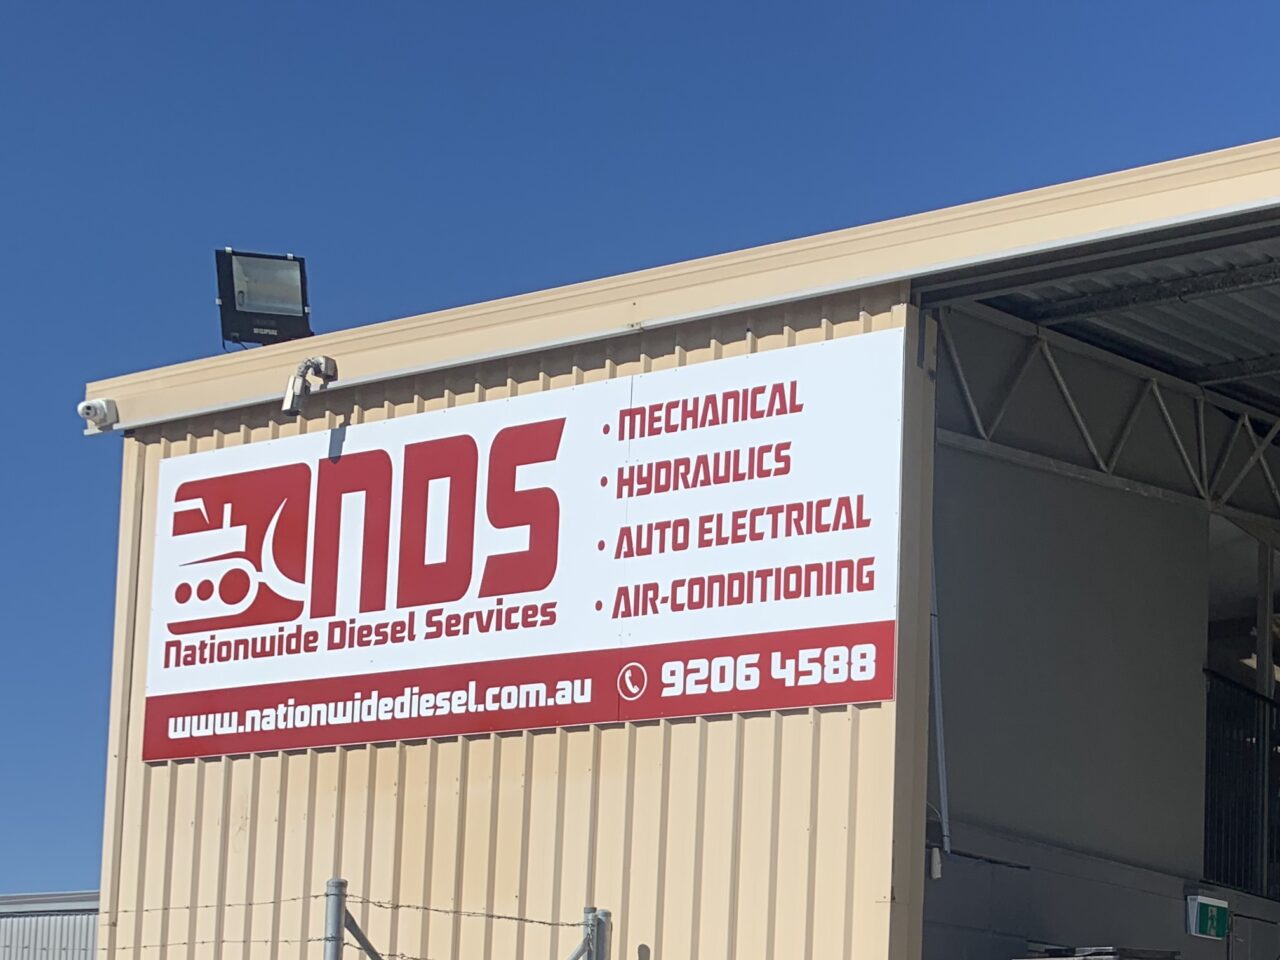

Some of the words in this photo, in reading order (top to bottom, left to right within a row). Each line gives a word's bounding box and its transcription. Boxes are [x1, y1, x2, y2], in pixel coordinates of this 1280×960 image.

[618, 380, 804, 441] MECHANICAL
[616, 441, 792, 499] HYDRAULICS
[309, 417, 566, 619] NDS
[614, 517, 690, 559] AUTO
[698, 494, 871, 548] ELECTRICAL
[612, 557, 875, 619] AIR-CONDITIONING
[163, 623, 318, 668] Nationwide
[327, 611, 417, 651] Diesel
[424, 597, 558, 640] Services
[661, 653, 760, 697] 9206
[770, 643, 876, 687] 4588
[167, 678, 592, 739] www.nationwidediesel.com.au
